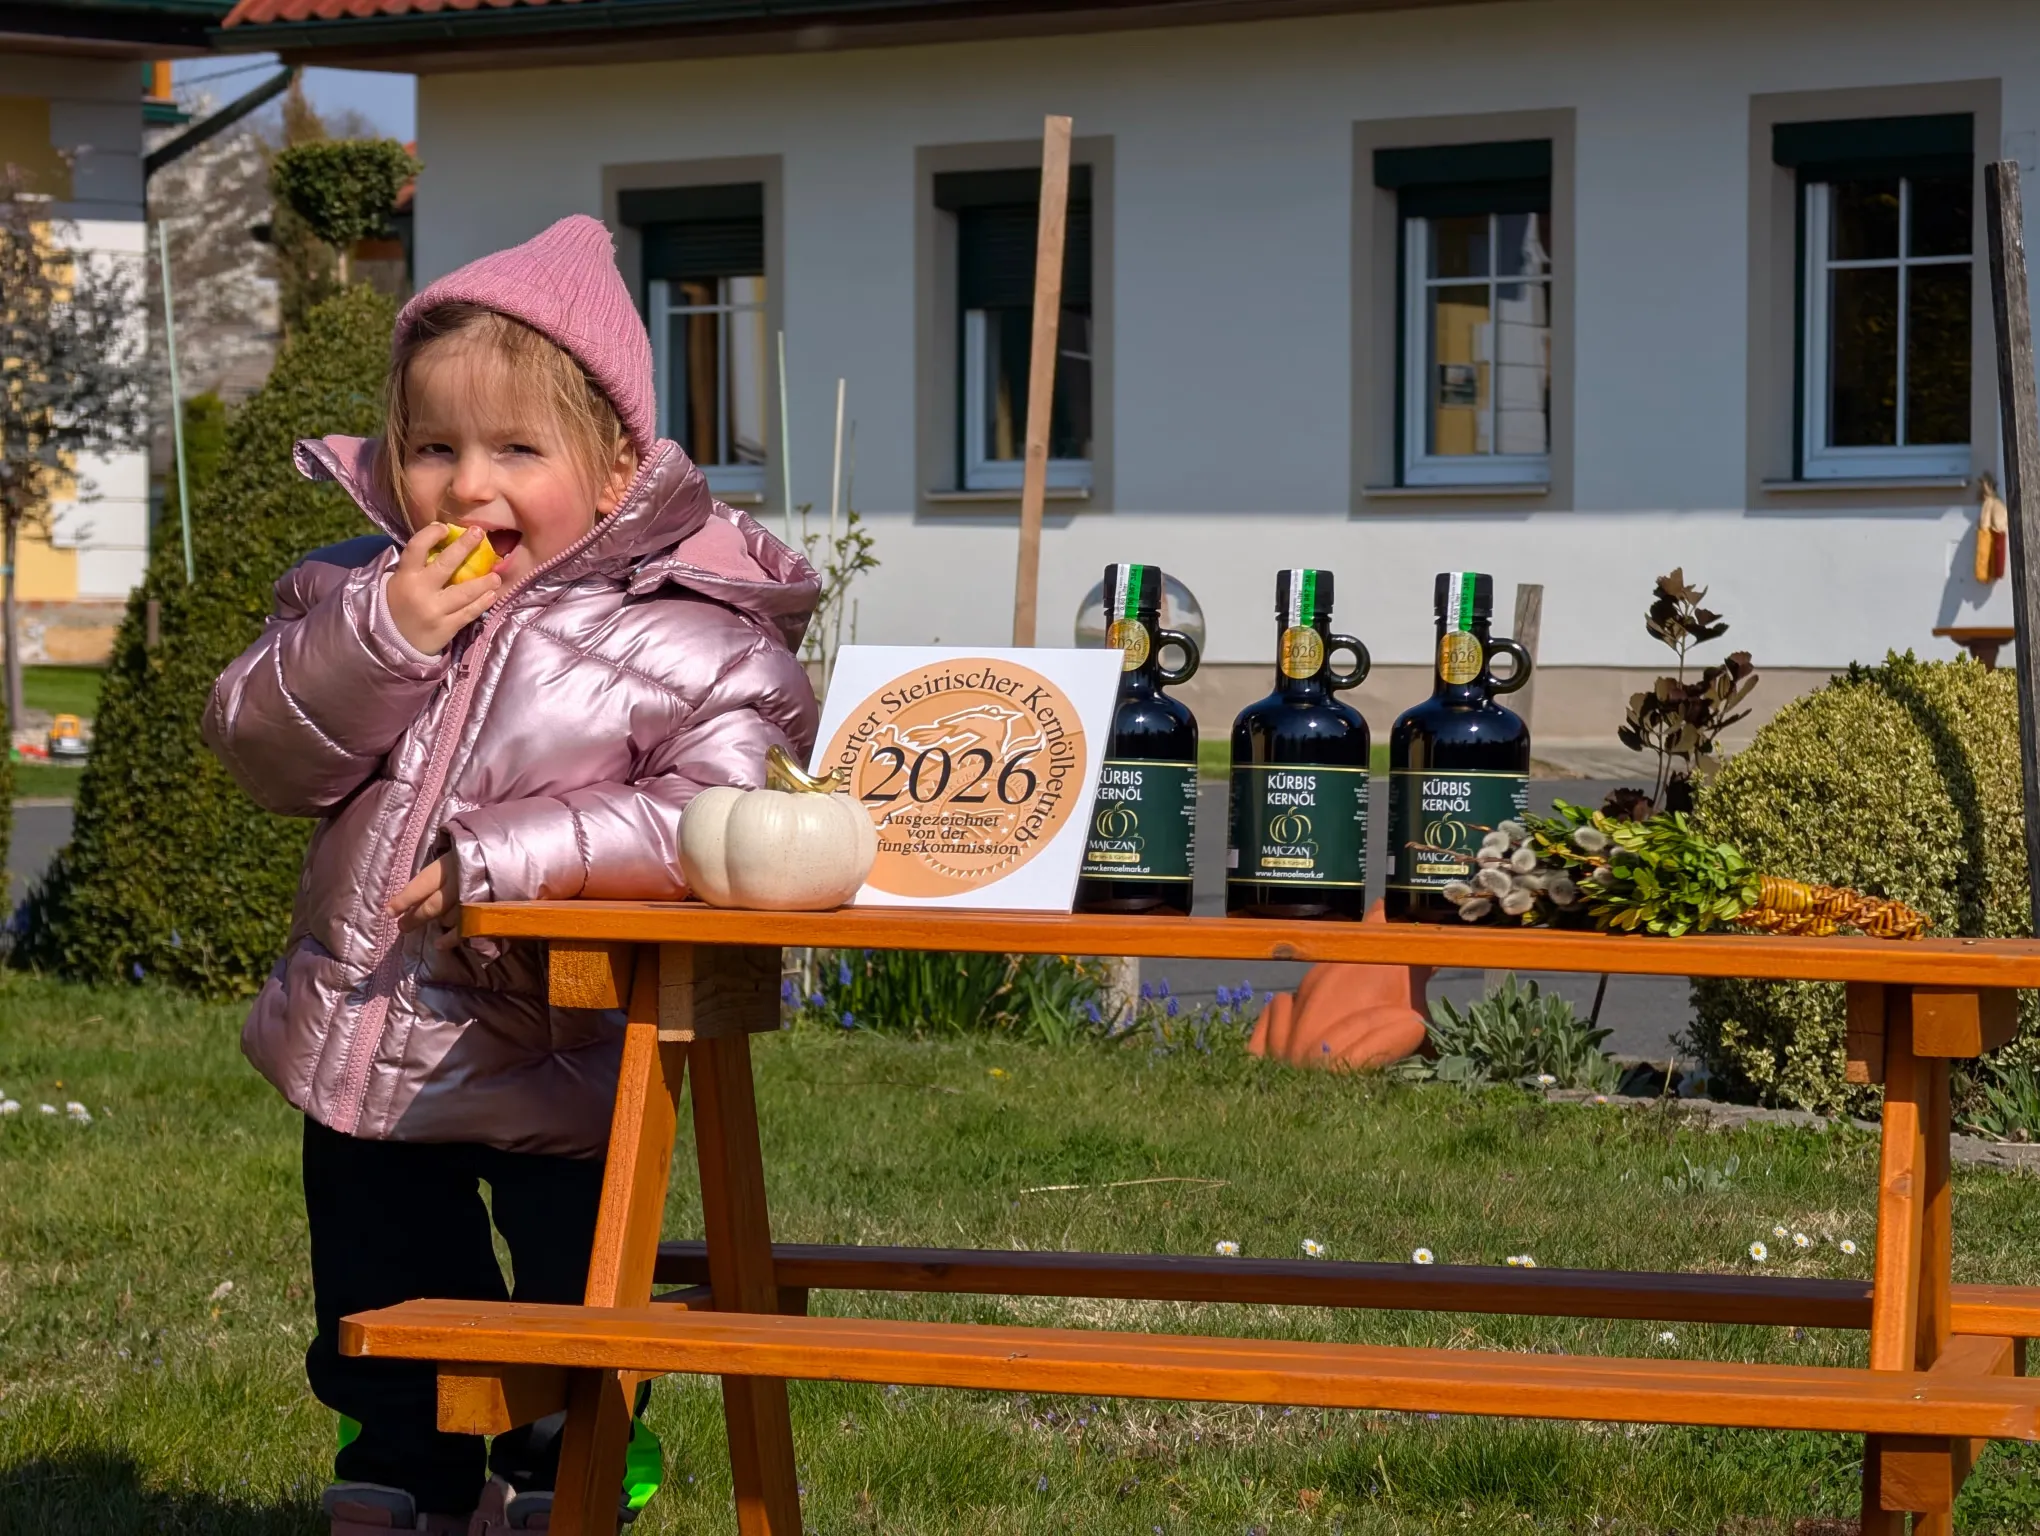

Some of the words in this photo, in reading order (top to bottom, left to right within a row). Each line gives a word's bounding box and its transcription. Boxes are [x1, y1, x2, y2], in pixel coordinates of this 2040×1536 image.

[1111, 638, 1141, 651] 2026
[1285, 646, 1316, 658] 2026
[1443, 651, 1475, 663] 2026
[881, 668, 1023, 714] Steirischer
[1014, 685, 1075, 842] Kernölbetrieb
[861, 746, 1042, 805] 2026
[1267, 772, 1316, 790] KÜRBIS
[1095, 786, 1143, 801] KERNÖL
[1422, 778, 1471, 796] KÜRBIS
[1267, 791, 1316, 806] KERNÖL
[1422, 797, 1471, 812] KERNÖL
[880, 812, 999, 829] Ausgezeichnet
[907, 830, 935, 840] von
[941, 827, 967, 840] der
[1089, 840, 1136, 853] MAJCZAN
[1262, 845, 1310, 858] MAJCZAN
